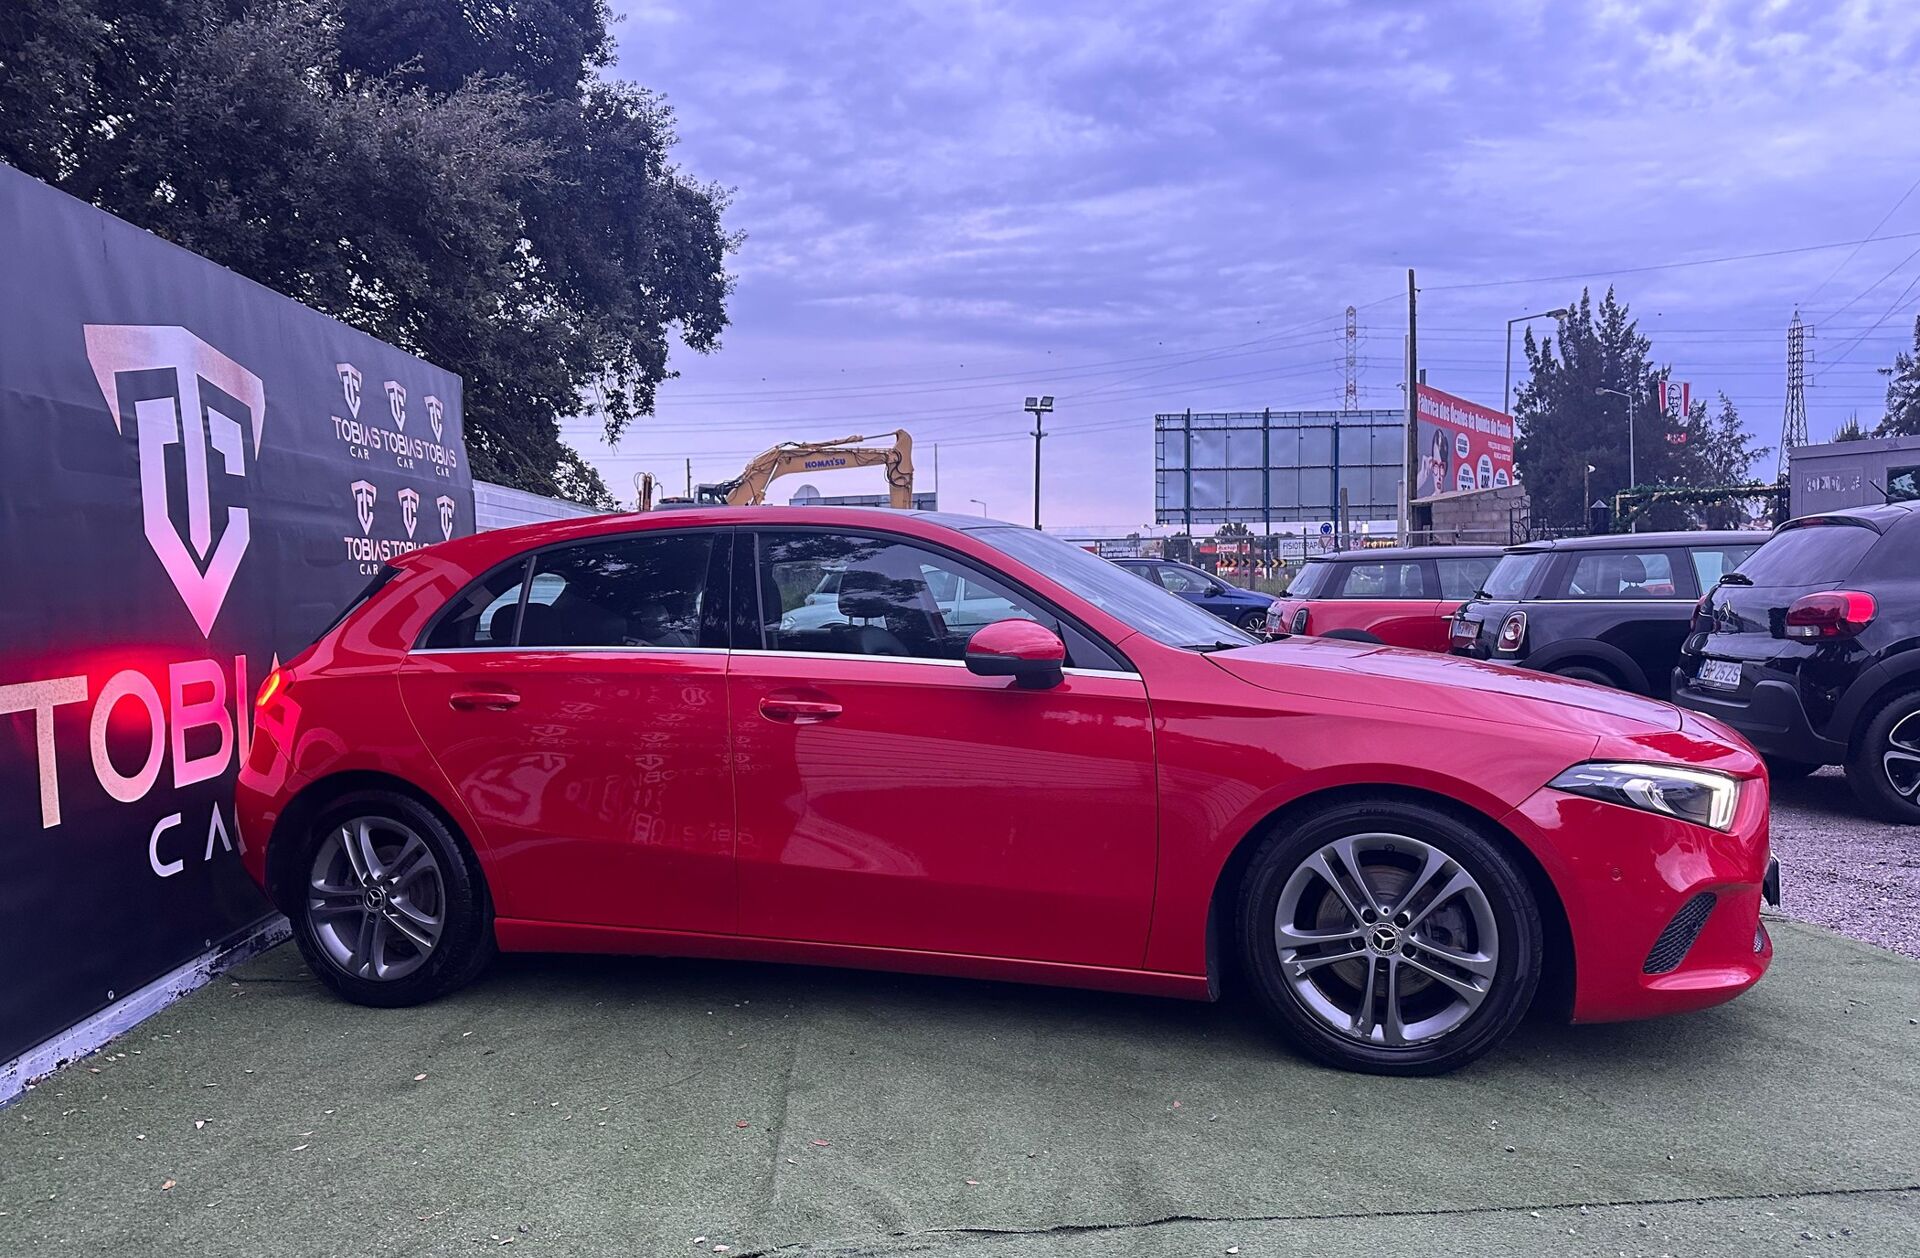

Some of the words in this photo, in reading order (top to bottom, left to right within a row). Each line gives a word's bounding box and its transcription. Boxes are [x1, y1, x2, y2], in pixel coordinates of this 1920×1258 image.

[331, 415, 380, 449] TOBIAS
[349, 446, 369, 460] CAR
[380, 429, 423, 459] TOBIAS
[397, 456, 414, 470] CAR
[421, 440, 456, 468] TOBIAS
[805, 458, 846, 468] KOMATSU
[435, 465, 450, 478] CAR
[343, 537, 391, 562] TOBIAS
[1282, 542, 1321, 551] FISIOTERAP
[359, 563, 379, 575] CAR
[0, 653, 281, 830] TOBI
[149, 801, 233, 878] CA
